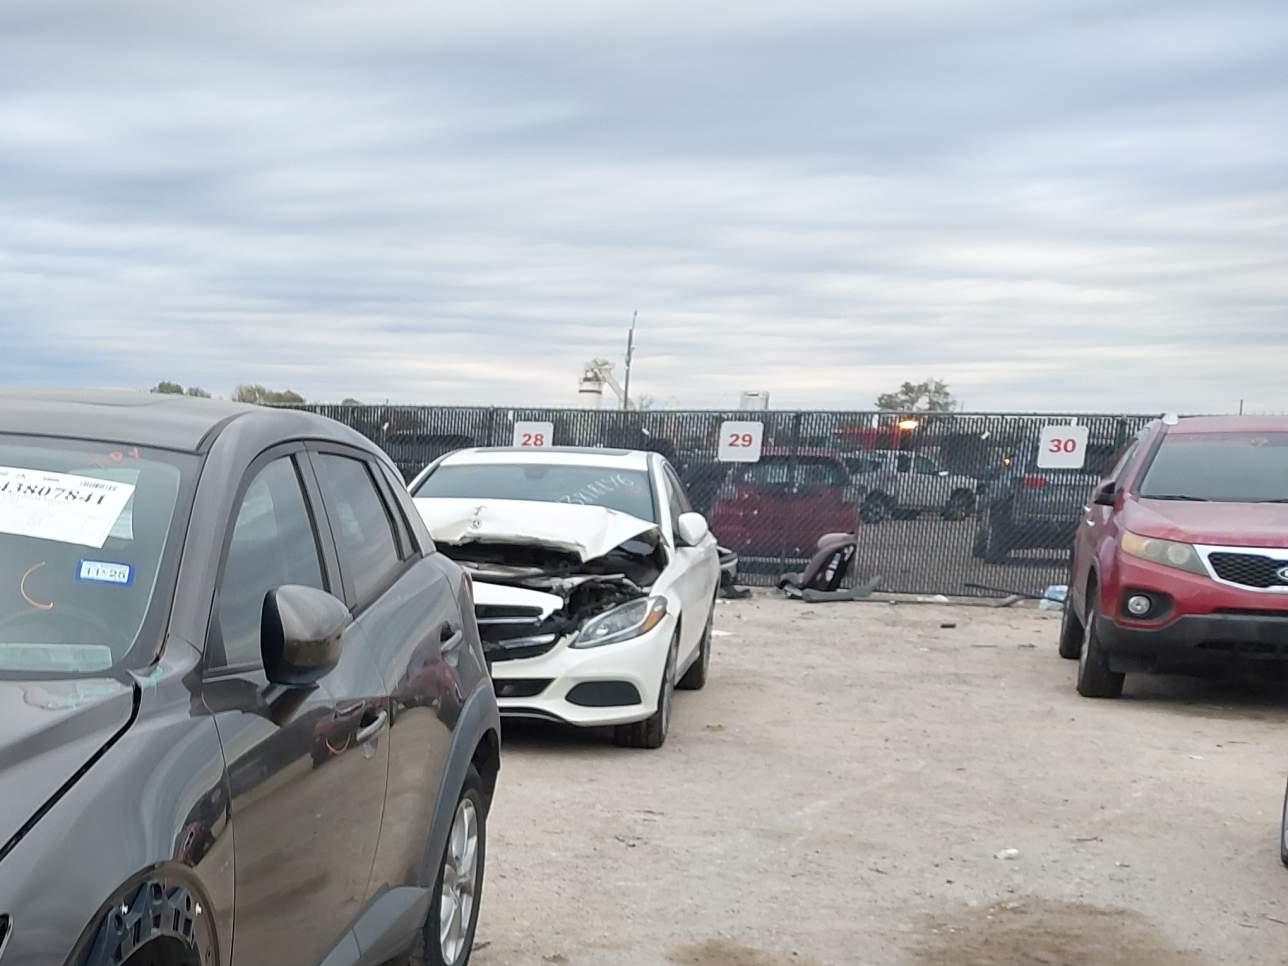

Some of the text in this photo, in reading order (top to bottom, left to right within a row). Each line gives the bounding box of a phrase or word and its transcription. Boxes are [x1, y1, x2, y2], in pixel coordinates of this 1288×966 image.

[520, 432, 545, 447] 28
[727, 433, 753, 448] 29
[1048, 438, 1077, 453] 30
